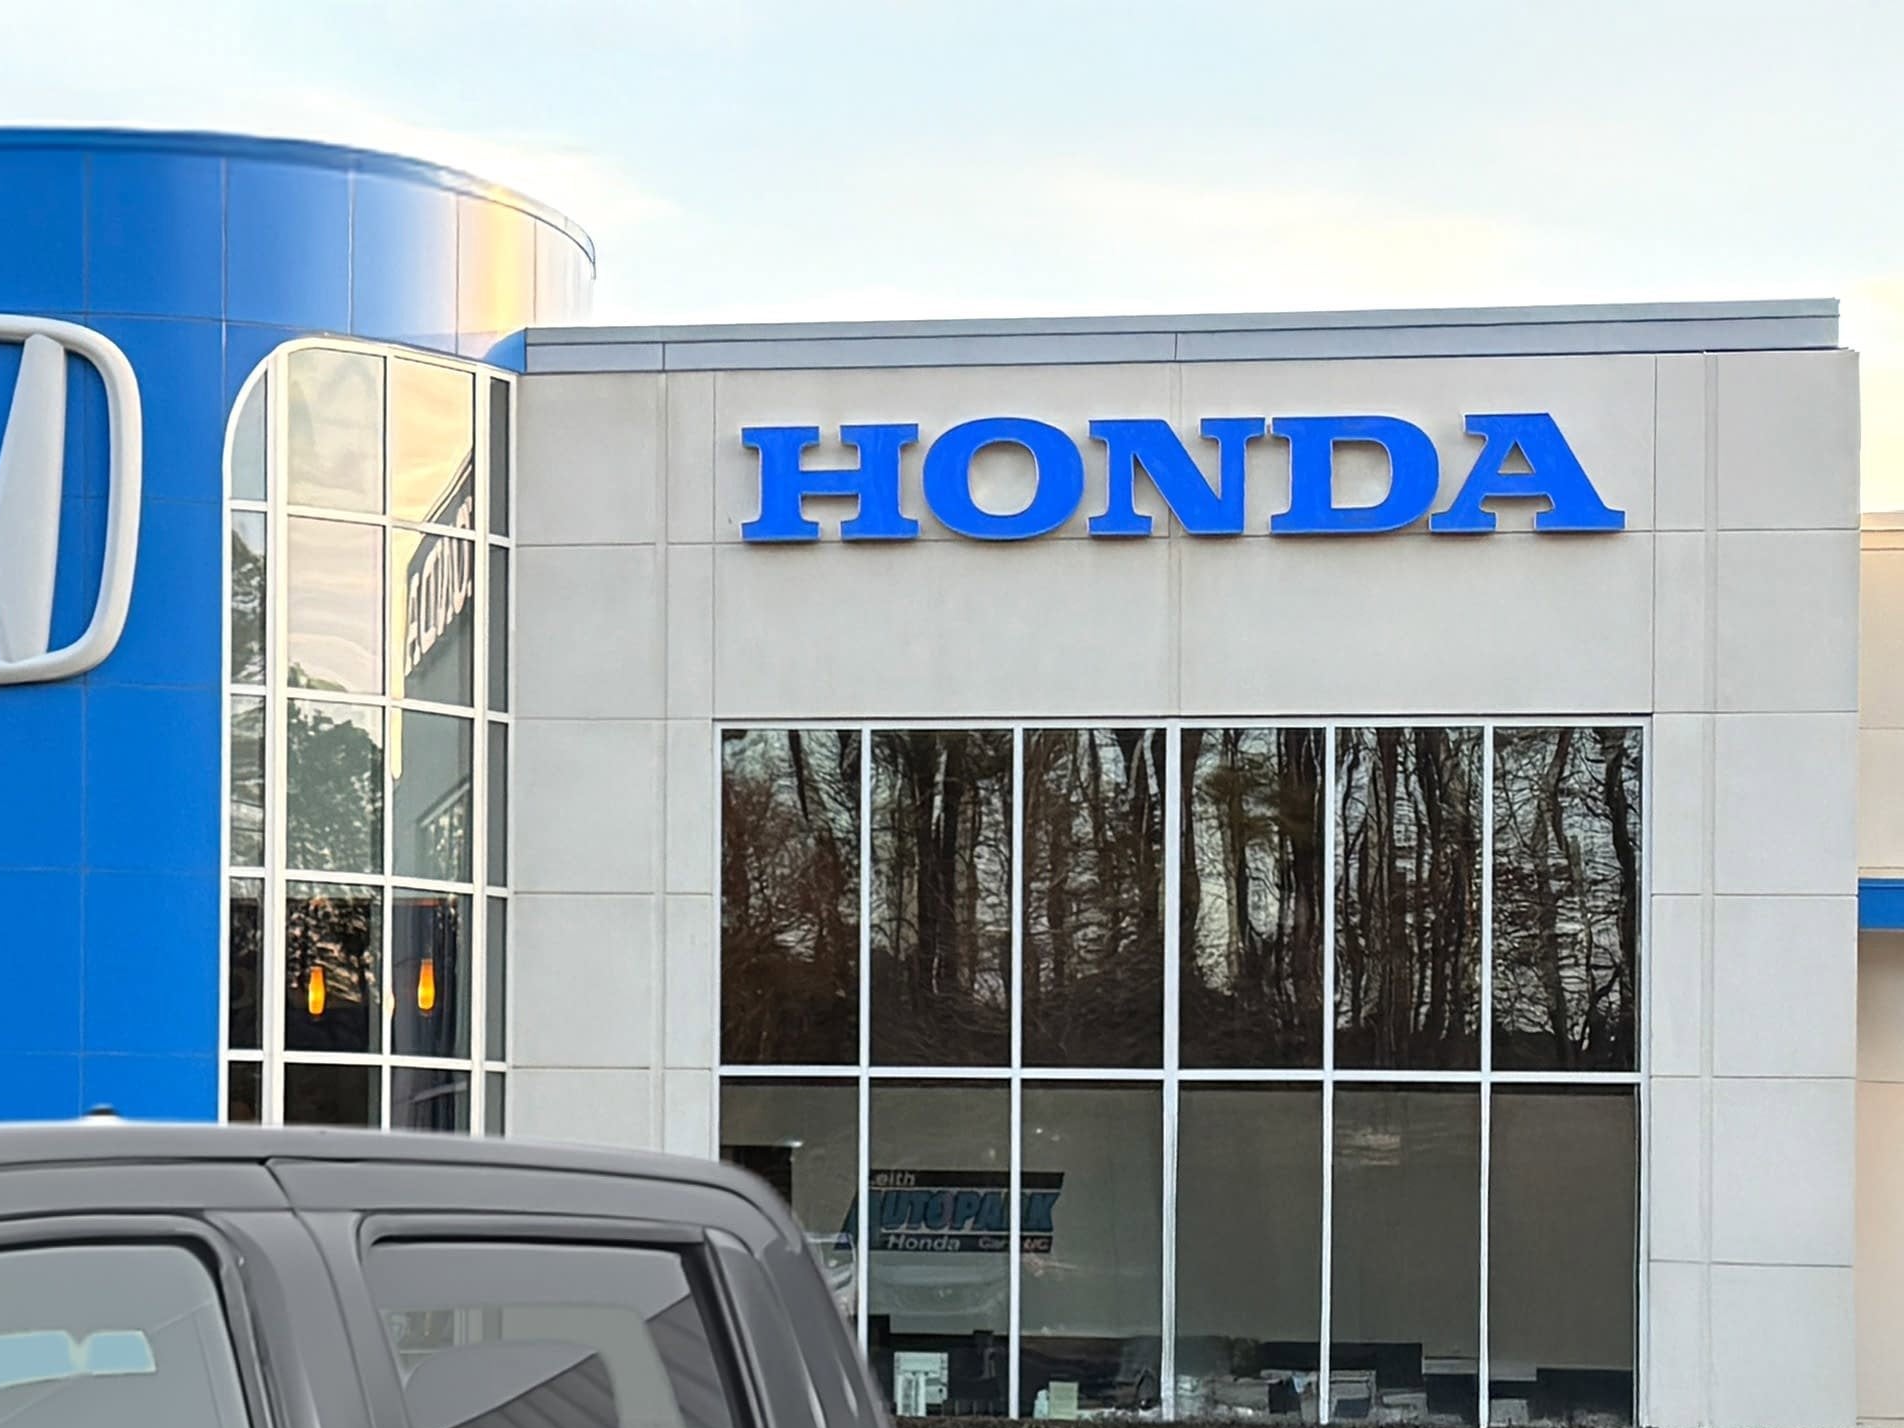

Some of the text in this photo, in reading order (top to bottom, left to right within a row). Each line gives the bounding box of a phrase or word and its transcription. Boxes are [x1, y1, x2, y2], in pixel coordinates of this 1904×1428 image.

[741, 412, 1626, 541] HONDA
[871, 1171, 916, 1187] eith
[887, 1234, 961, 1251] Honda
